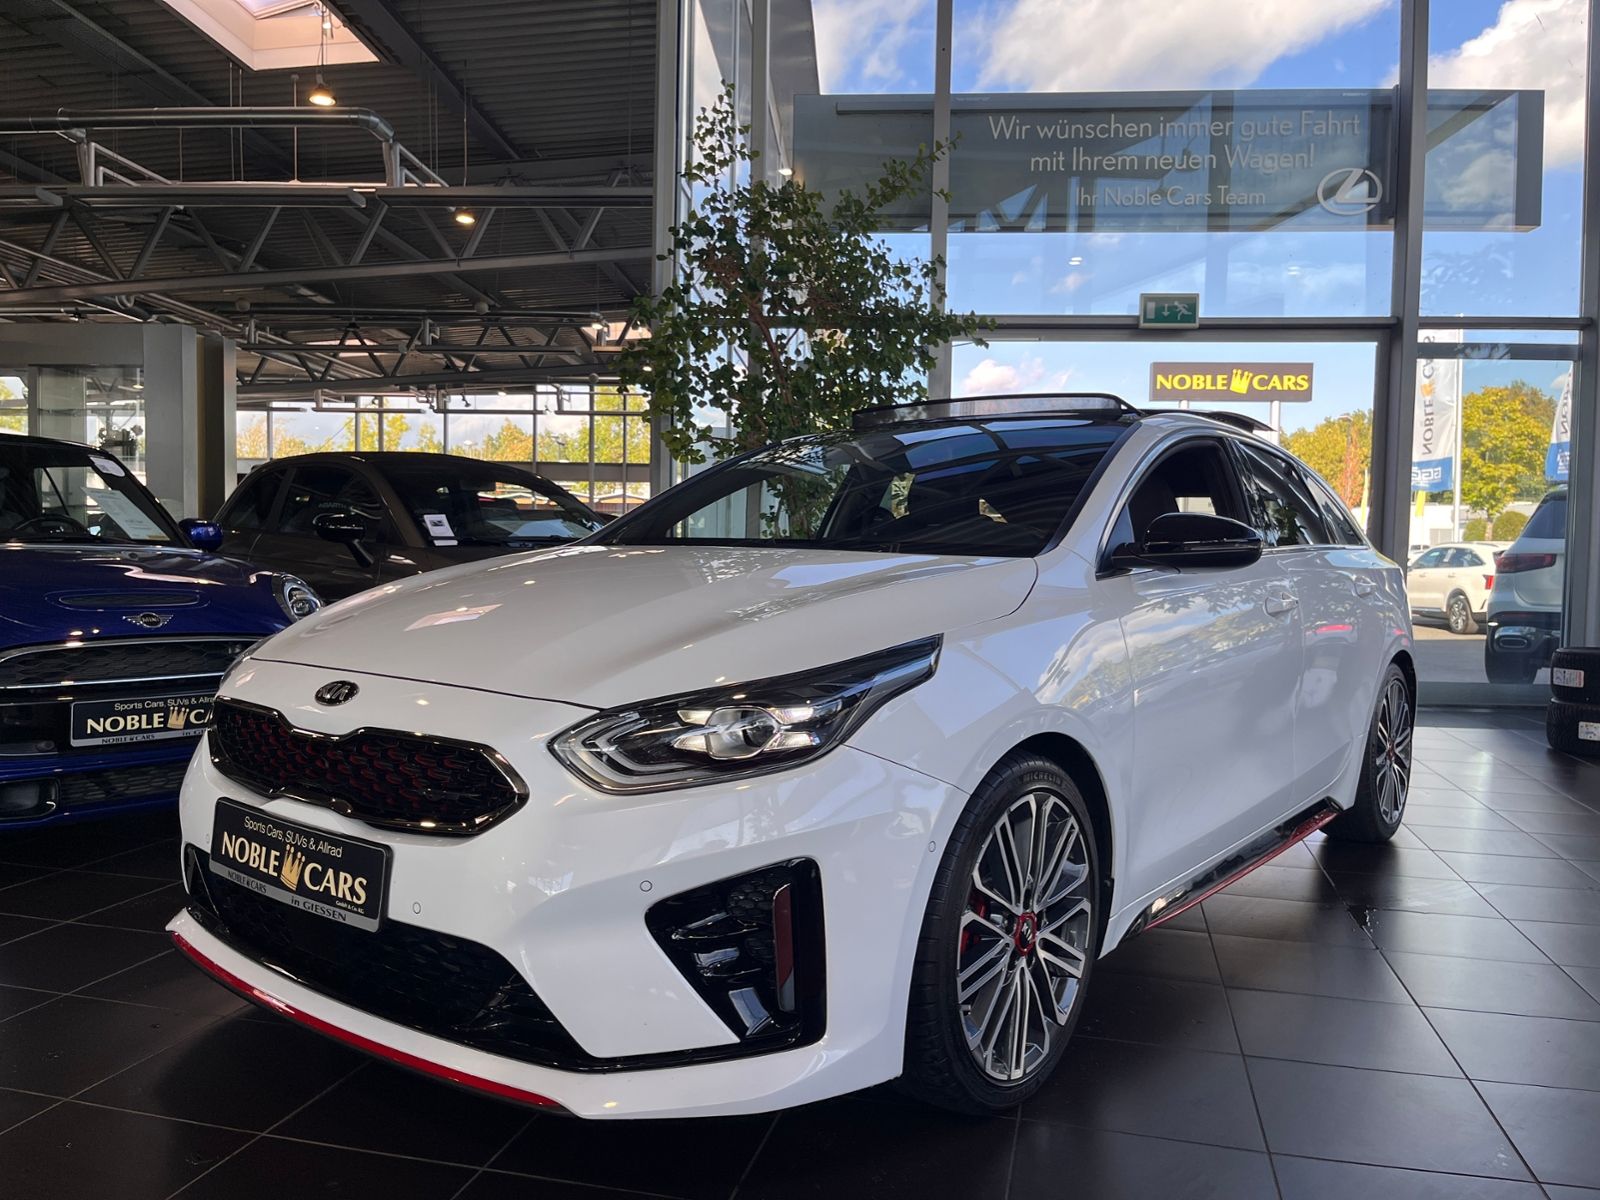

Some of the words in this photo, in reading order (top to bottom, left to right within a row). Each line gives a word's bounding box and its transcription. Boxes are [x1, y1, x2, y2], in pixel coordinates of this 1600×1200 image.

[988, 115, 1031, 140] Wir
[1036, 114, 1152, 139] wünschen
[1159, 116, 1234, 137] immer
[1240, 115, 1294, 141] gute
[1301, 110, 1361, 136] Fahrt
[1030, 151, 1065, 172] mit
[1072, 146, 1138, 171] Ihrem
[1145, 153, 1217, 170] neuen
[1224, 143, 1315, 174] Wagen!
[1075, 187, 1098, 206] Ihr
[1104, 186, 1162, 206] Noble
[1166, 186, 1212, 206] Cars
[1217, 185, 1266, 206] Team
[1156, 373, 1229, 391] NOBLE
[1251, 374, 1310, 392] CARS
[114, 702, 143, 711] Sports
[167, 698, 189, 707] SUVs
[191, 697, 197, 705] &
[86, 712, 165, 735] NOBLE
[243, 815, 266, 834] Sports
[266, 823, 285, 842] Cars,
[285, 830, 308, 848] SUVs
[308, 837, 317, 851] &
[317, 840, 343, 858] Allrad
[221, 831, 281, 877] NOBLE
[304, 862, 368, 905] CARS
[227, 870, 247, 885] NOBLE
[251, 879, 267, 894] CARS
[291, 895, 300, 905] in
[303, 898, 347, 921] GIESSEN
